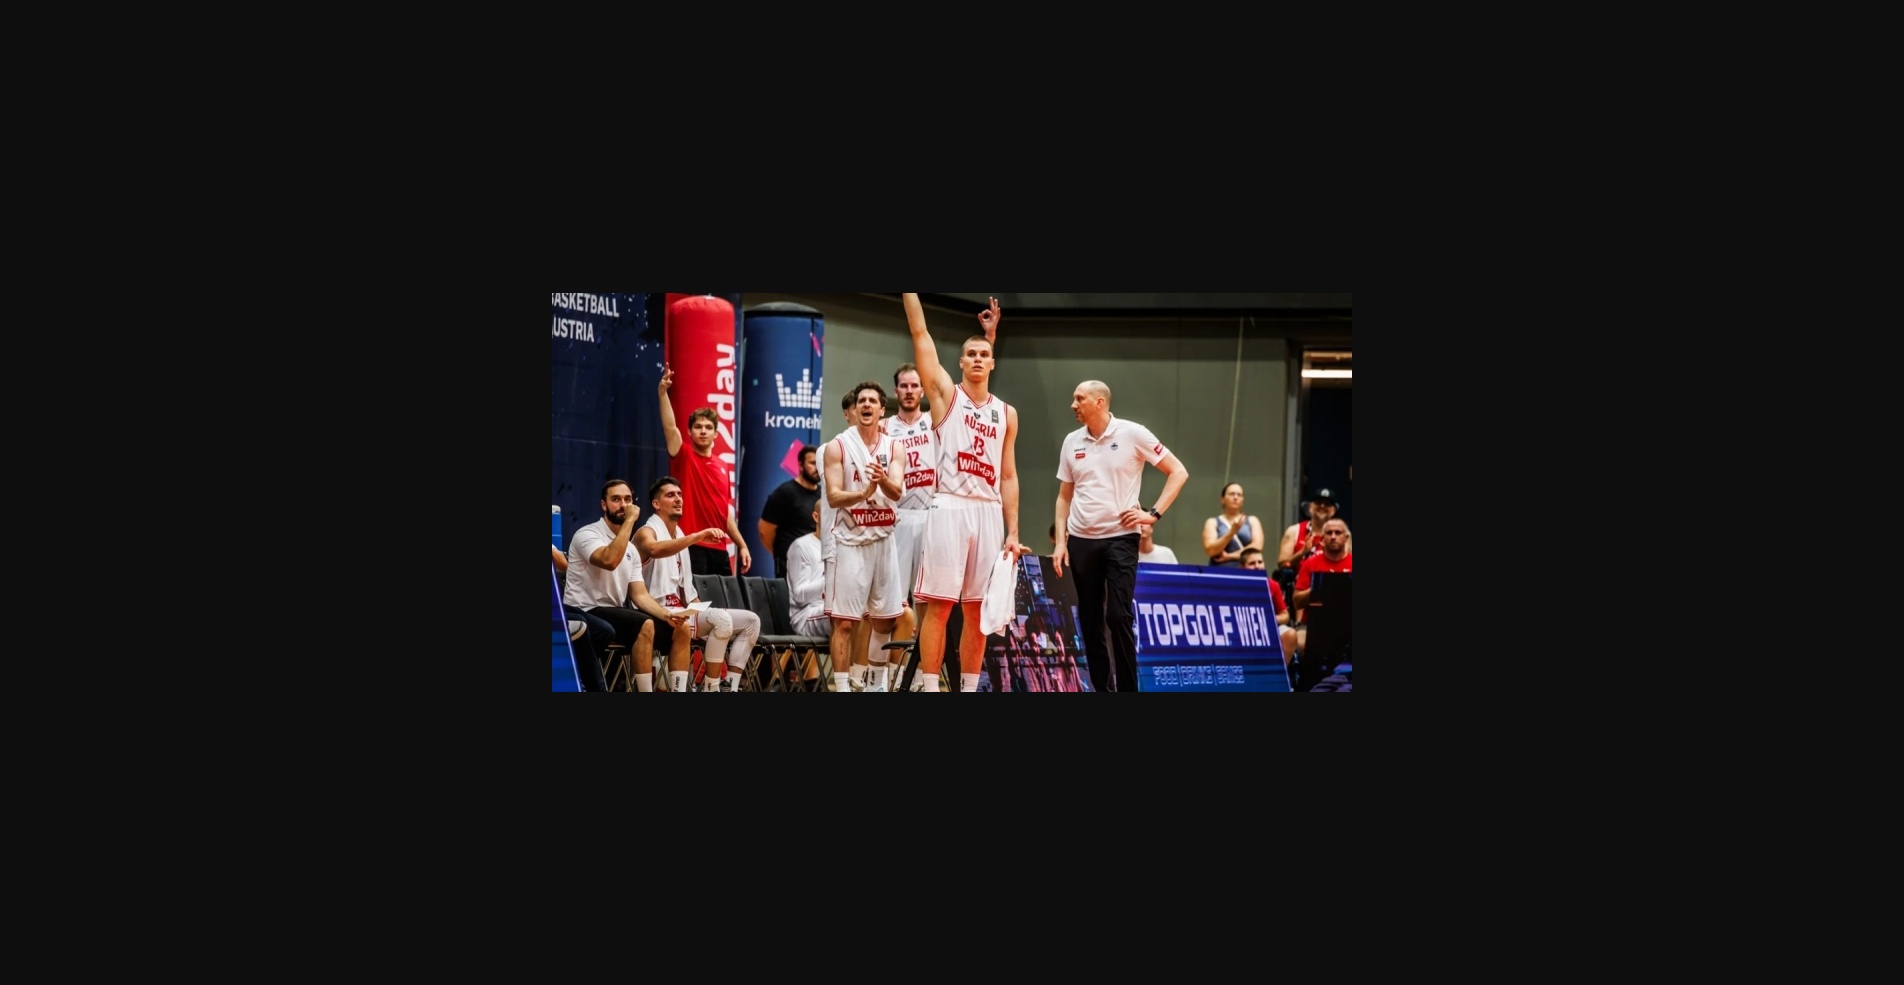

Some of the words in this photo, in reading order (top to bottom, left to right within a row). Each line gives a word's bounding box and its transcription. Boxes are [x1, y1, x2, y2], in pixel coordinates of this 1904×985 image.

[552, 316, 594, 342] USTRIA
[964, 414, 997, 440] AURIA
[900, 433, 930, 449] STRIA
[973, 435, 985, 457] 13
[907, 451, 921, 469] 12
[904, 472, 934, 487] in2day
[1138, 603, 1234, 647] TOPGOLF
[1233, 605, 1271, 647] WIEN
